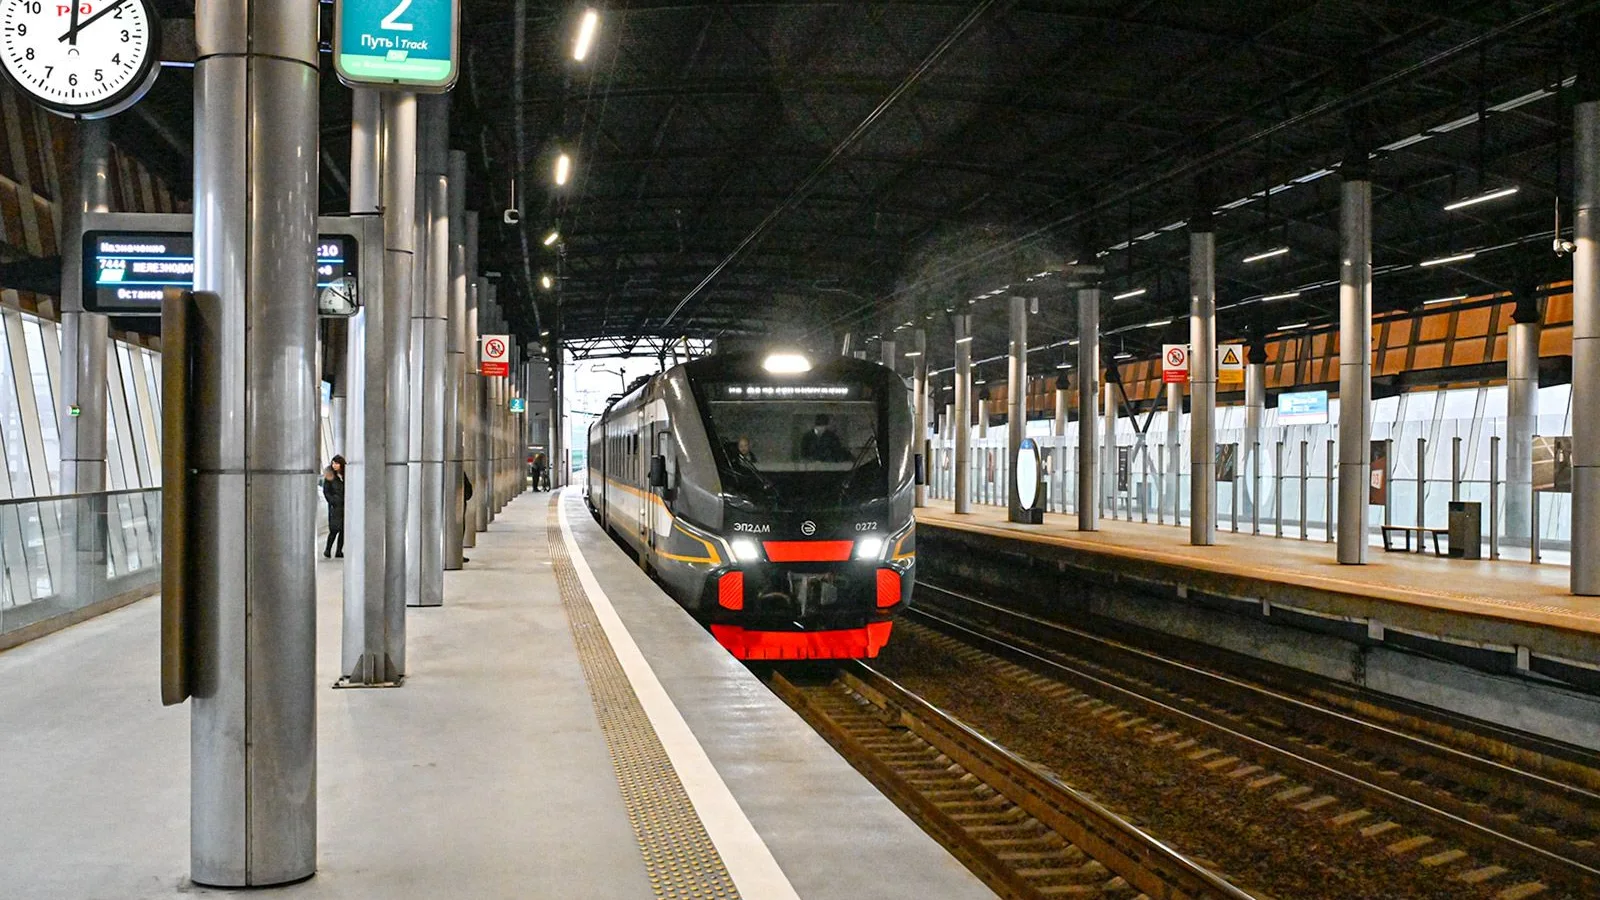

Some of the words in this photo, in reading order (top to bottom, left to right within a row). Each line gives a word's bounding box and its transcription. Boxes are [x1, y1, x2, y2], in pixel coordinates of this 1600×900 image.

[23, 0, 42, 14] 10
[113, 6, 123, 20] 2
[381, 0, 414, 31] 2
[17, 23, 27, 36] 9
[120, 29, 130, 42] 3
[361, 34, 394, 50] Путь
[401, 39, 428, 50] Track
[25, 47, 35, 60] 8
[111, 53, 121, 65] 4
[44, 66, 54, 79] 7
[94, 69, 103, 82] 5
[68, 73, 78, 86] 6
[100, 242, 166, 253] Назначение
[734, 522, 771, 533] ЭП2ДМ
[855, 521, 877, 531] 0272
